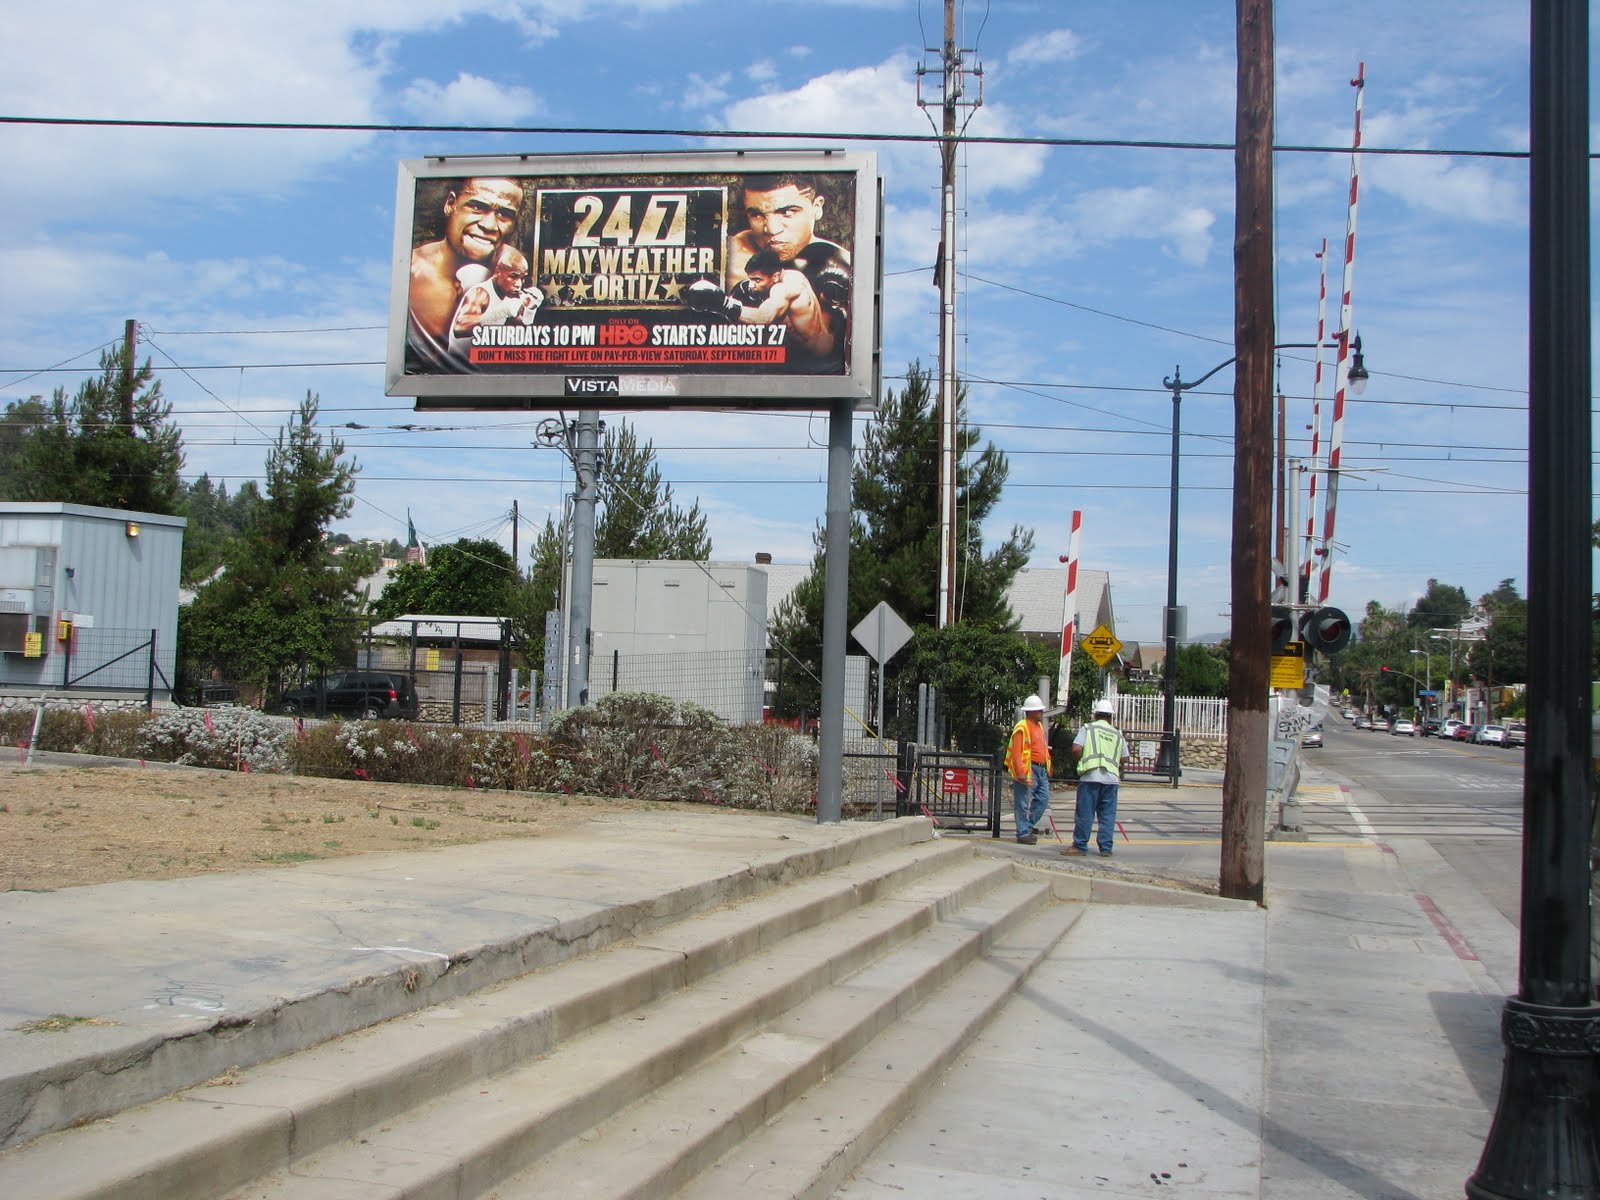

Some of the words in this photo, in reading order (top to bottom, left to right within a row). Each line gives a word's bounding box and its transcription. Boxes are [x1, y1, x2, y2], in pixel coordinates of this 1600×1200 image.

[543, 247, 714, 274] MAYWEATHER
[593, 274, 661, 300] ORTIZ
[471, 324, 550, 346] SATURDAYS
[552, 325, 571, 346] 10
[571, 324, 596, 346] PM
[600, 324, 648, 345] HBO
[651, 324, 707, 346] STARTS
[708, 324, 765, 346] AUGUST
[768, 324, 787, 346] 27
[477, 351, 501, 361] DON'T
[504, 351, 526, 361] MISS
[528, 350, 543, 361] THE
[545, 350, 569, 361] FIGHT
[571, 350, 589, 361] LIVE
[590, 350, 601, 361] ON
[604, 350, 662, 361] PAY-PER-VIEW
[663, 350, 709, 361] SATURDAY,
[711, 350, 762, 361] SEPTEMBER
[764, 350, 778, 361] 17!
